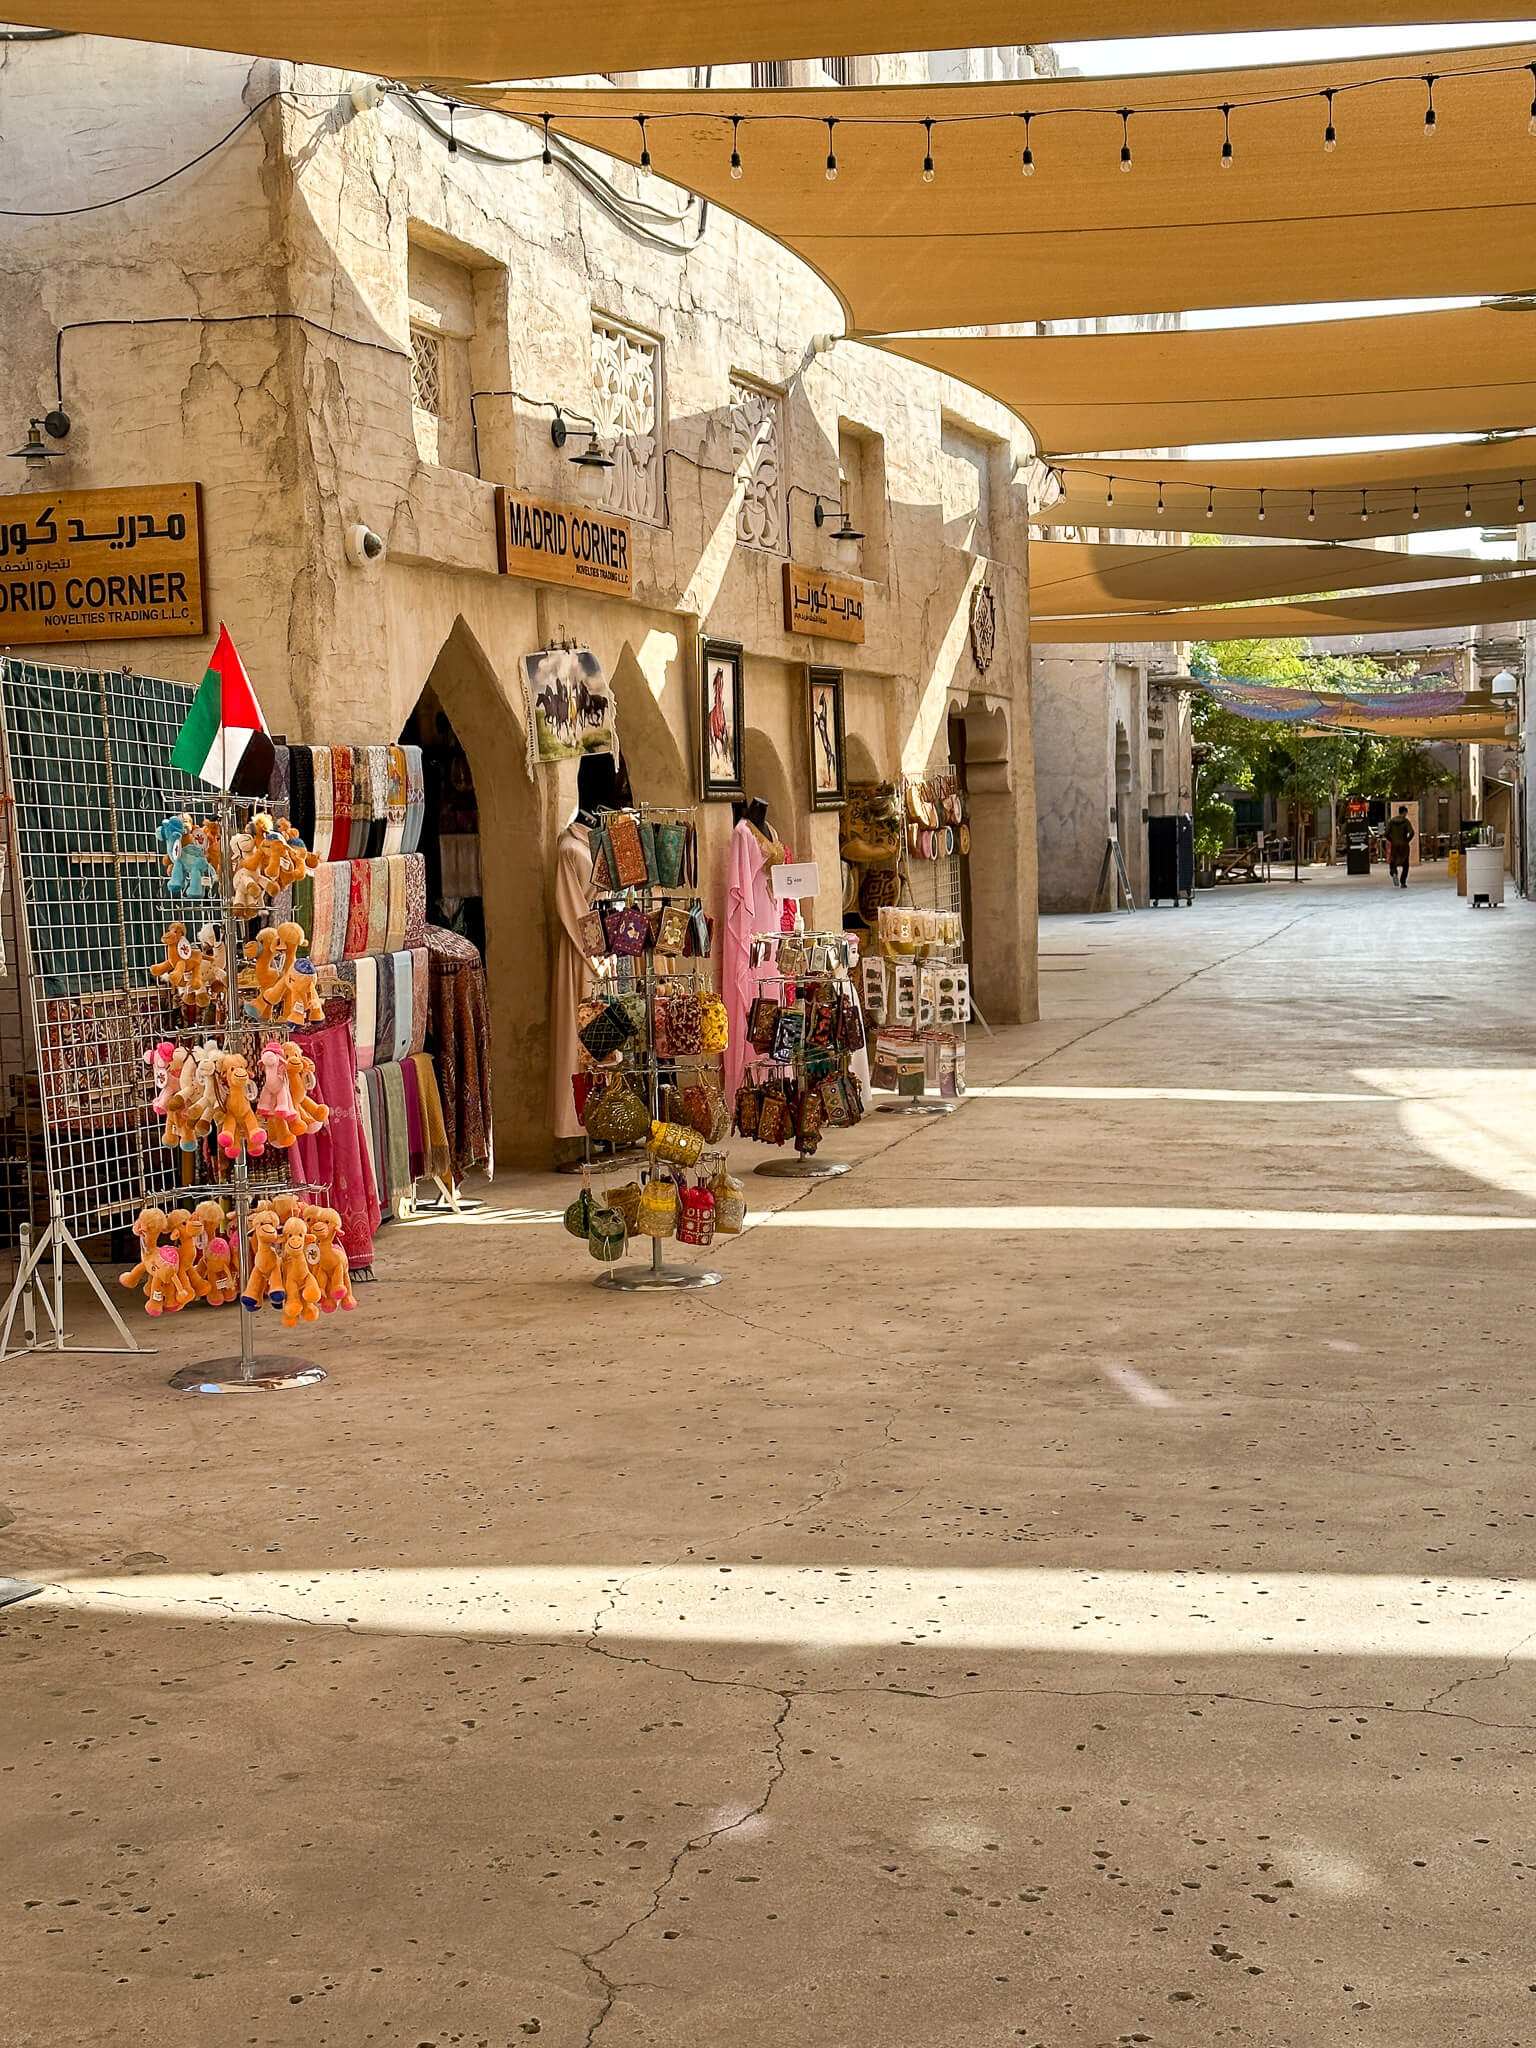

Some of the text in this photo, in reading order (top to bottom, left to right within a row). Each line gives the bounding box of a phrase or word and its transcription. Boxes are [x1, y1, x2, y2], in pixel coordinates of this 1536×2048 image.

[67, 513, 186, 550] مدريد
[509, 501, 628, 570] MADRID CORNER
[65, 572, 188, 609] CORNER
[830, 593, 862, 620] مدريد
[44, 612, 106, 626] NOVELTIES
[108, 609, 159, 623] TRADING
